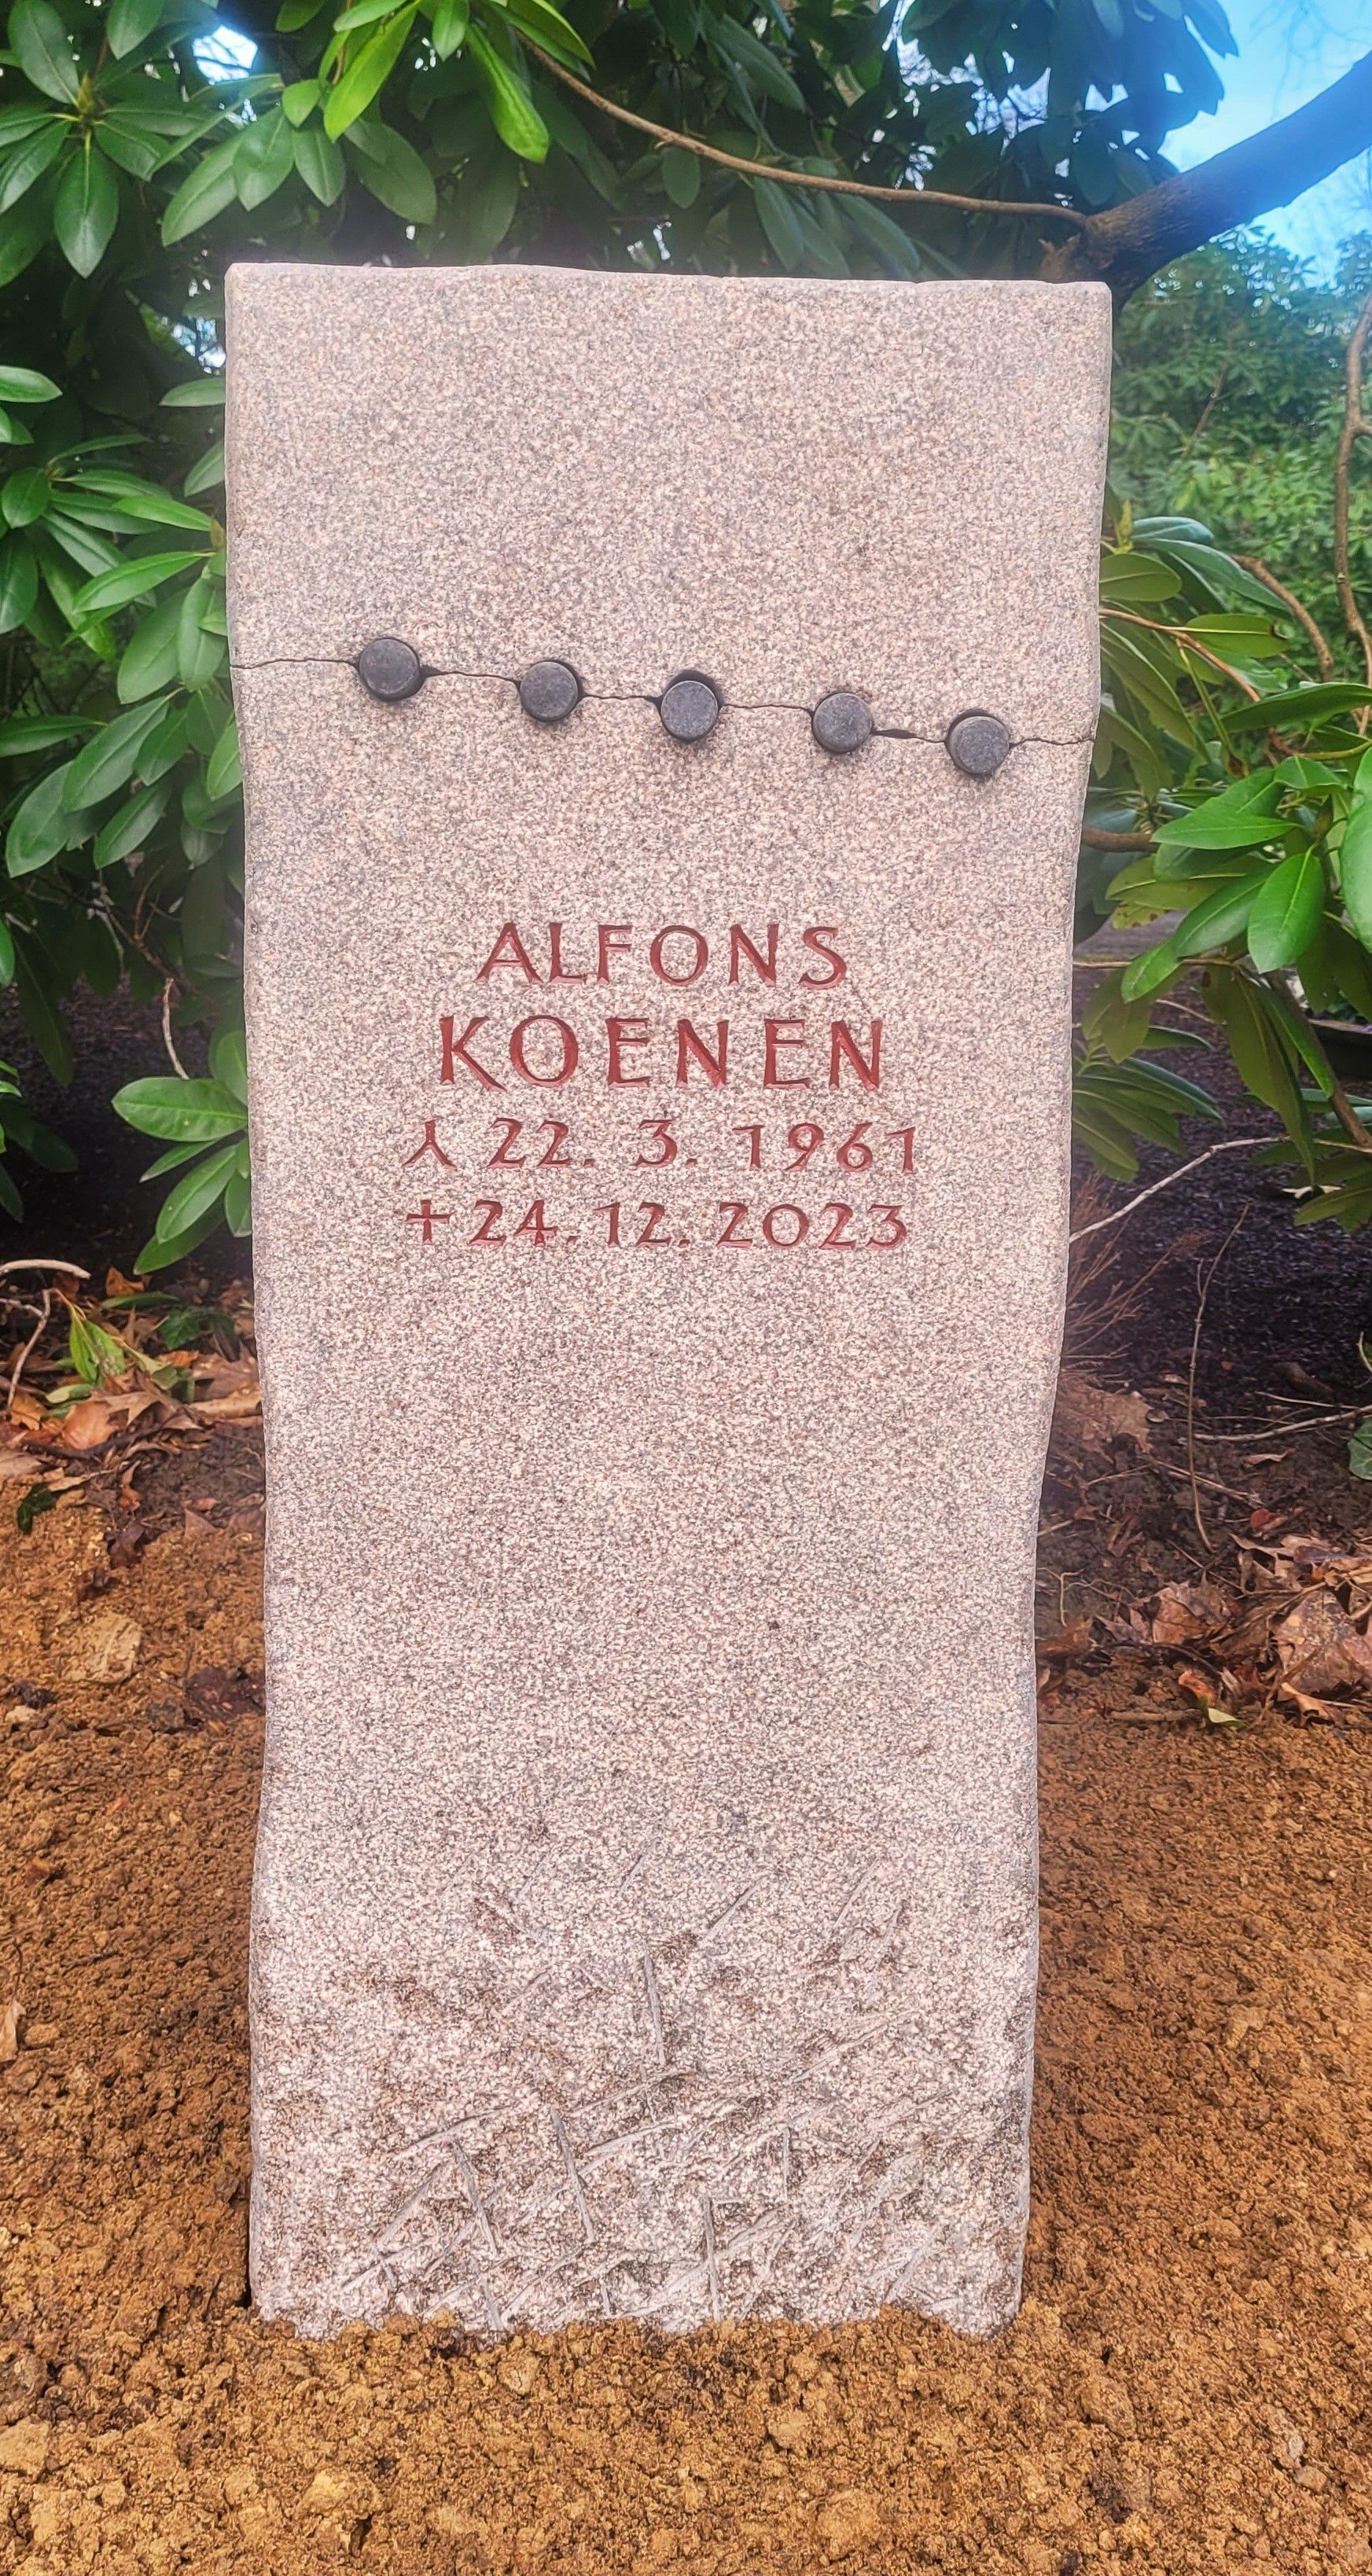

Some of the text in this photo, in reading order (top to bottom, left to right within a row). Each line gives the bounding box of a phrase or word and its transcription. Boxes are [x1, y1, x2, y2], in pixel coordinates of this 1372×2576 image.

[476, 921, 848, 990] ALFONS
[439, 1014, 885, 1092] KOENEN
[733, 1122, 917, 1174] 1961
